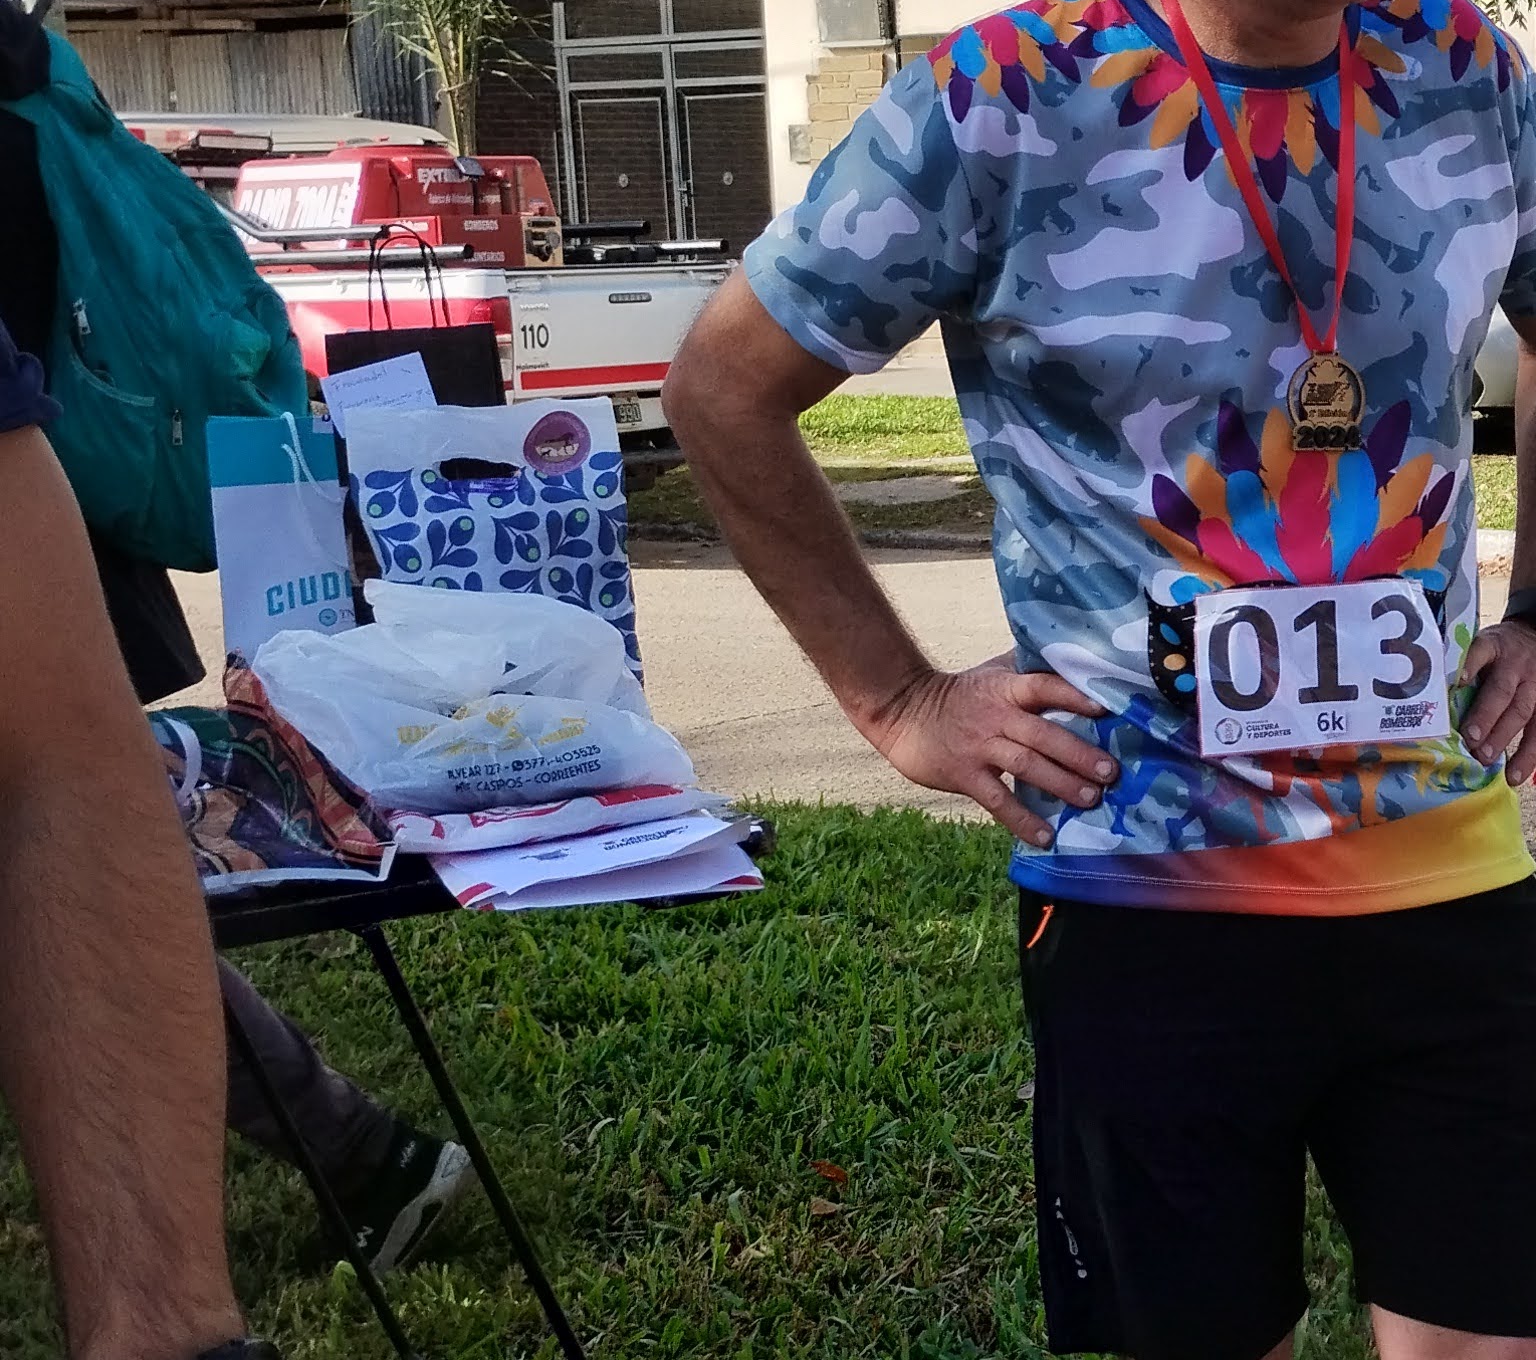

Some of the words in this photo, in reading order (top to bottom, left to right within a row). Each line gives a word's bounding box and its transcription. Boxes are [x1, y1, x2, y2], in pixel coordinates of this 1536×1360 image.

[521, 323, 549, 349] 110
[1297, 425, 1360, 449] 2024
[1208, 594, 1432, 711] 013
[1246, 723, 1279, 732] CULTURA
[1316, 710, 1344, 732] 6k
[1253, 729, 1292, 739] DEPORTES
